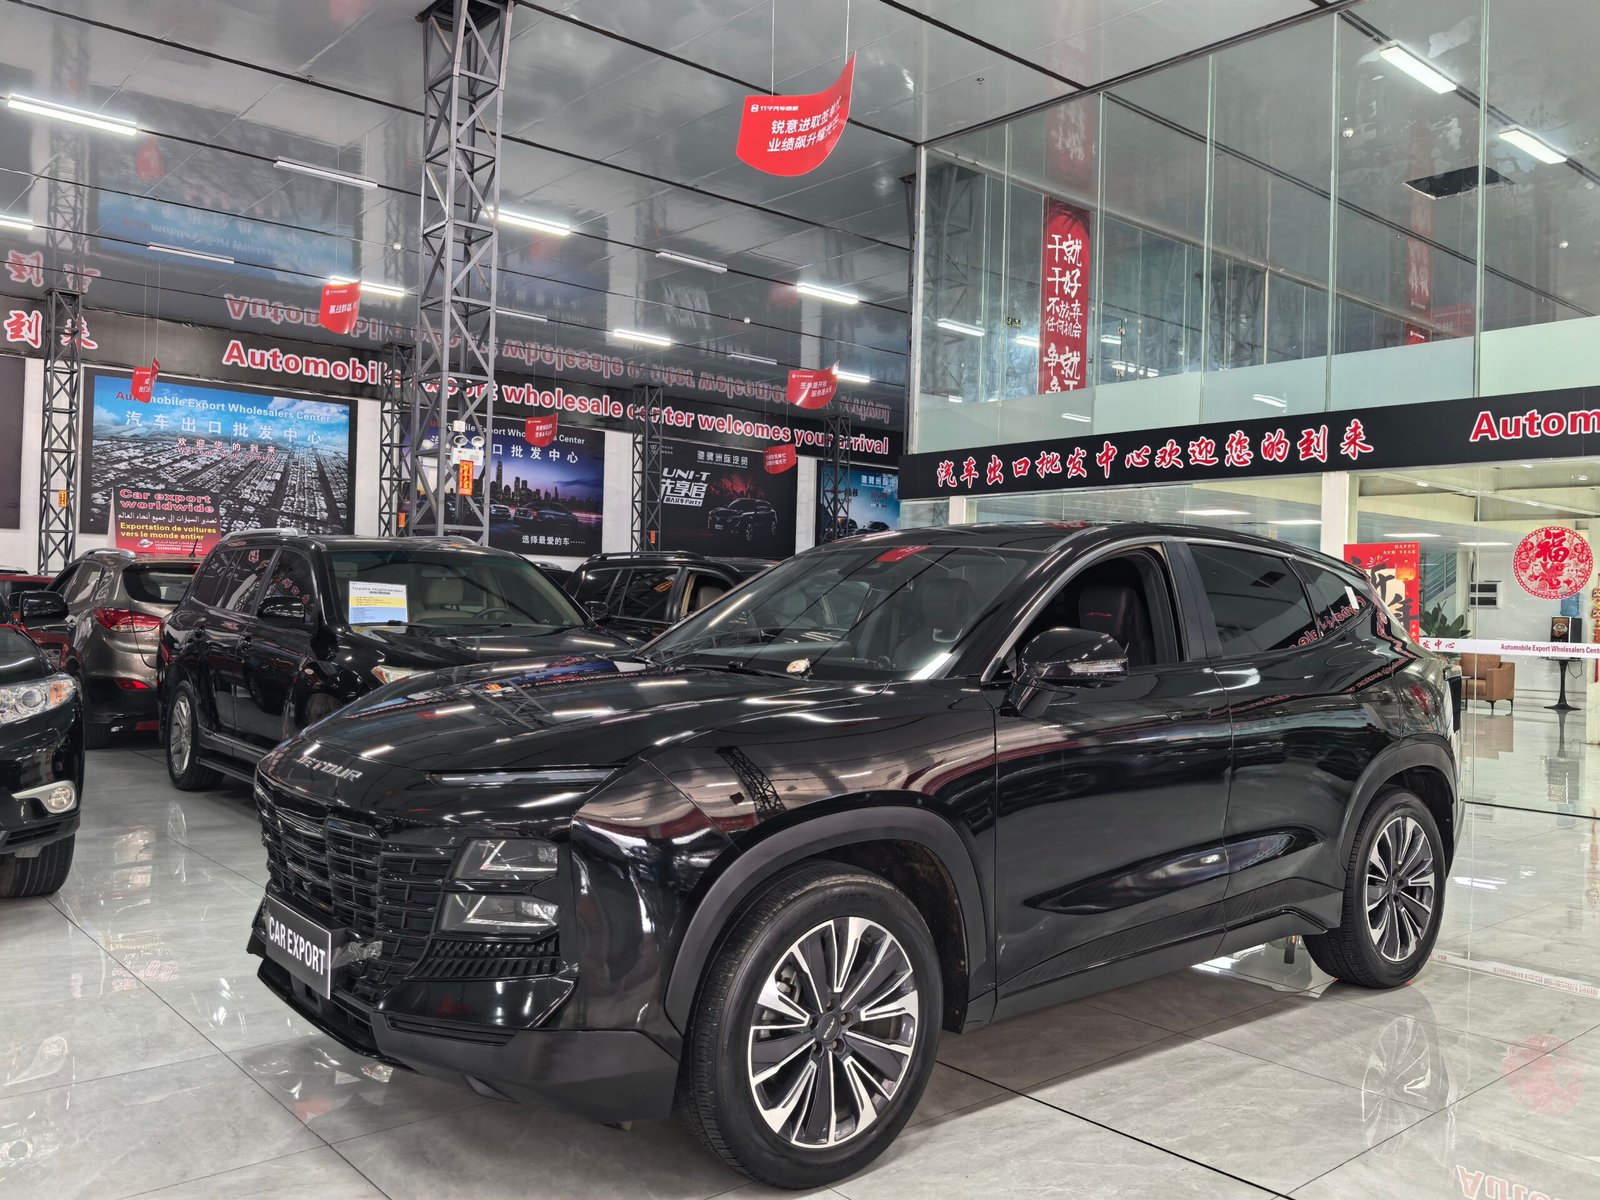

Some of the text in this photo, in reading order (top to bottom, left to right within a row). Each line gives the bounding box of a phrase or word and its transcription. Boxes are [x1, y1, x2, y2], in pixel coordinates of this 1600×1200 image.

[188, 399, 225, 411] Export
[227, 403, 294, 419] Wholesalers
[296, 411, 330, 422] Center
[502, 383, 623, 418] wholesale
[698, 414, 791, 442] welcomes
[125, 410, 322, 445] 汽车出口批发中心
[558, 434, 585, 445] Center
[936, 418, 1374, 489] 汽车出口批发中心欢迎您的到来
[662, 467, 711, 481] UNI-T
[120, 489, 211, 504] Car export
[120, 500, 215, 513] worldwide
[120, 522, 170, 532] Exportation
[183, 526, 217, 534] voitures
[120, 530, 139, 538] vers
[140, 530, 149, 538] le
[1500, 643, 1532, 652] Automobile
[1531, 644, 1551, 653] Export
[1551, 645, 1586, 655] Wholesalers
[268, 916, 327, 976] CAR EXPORT
